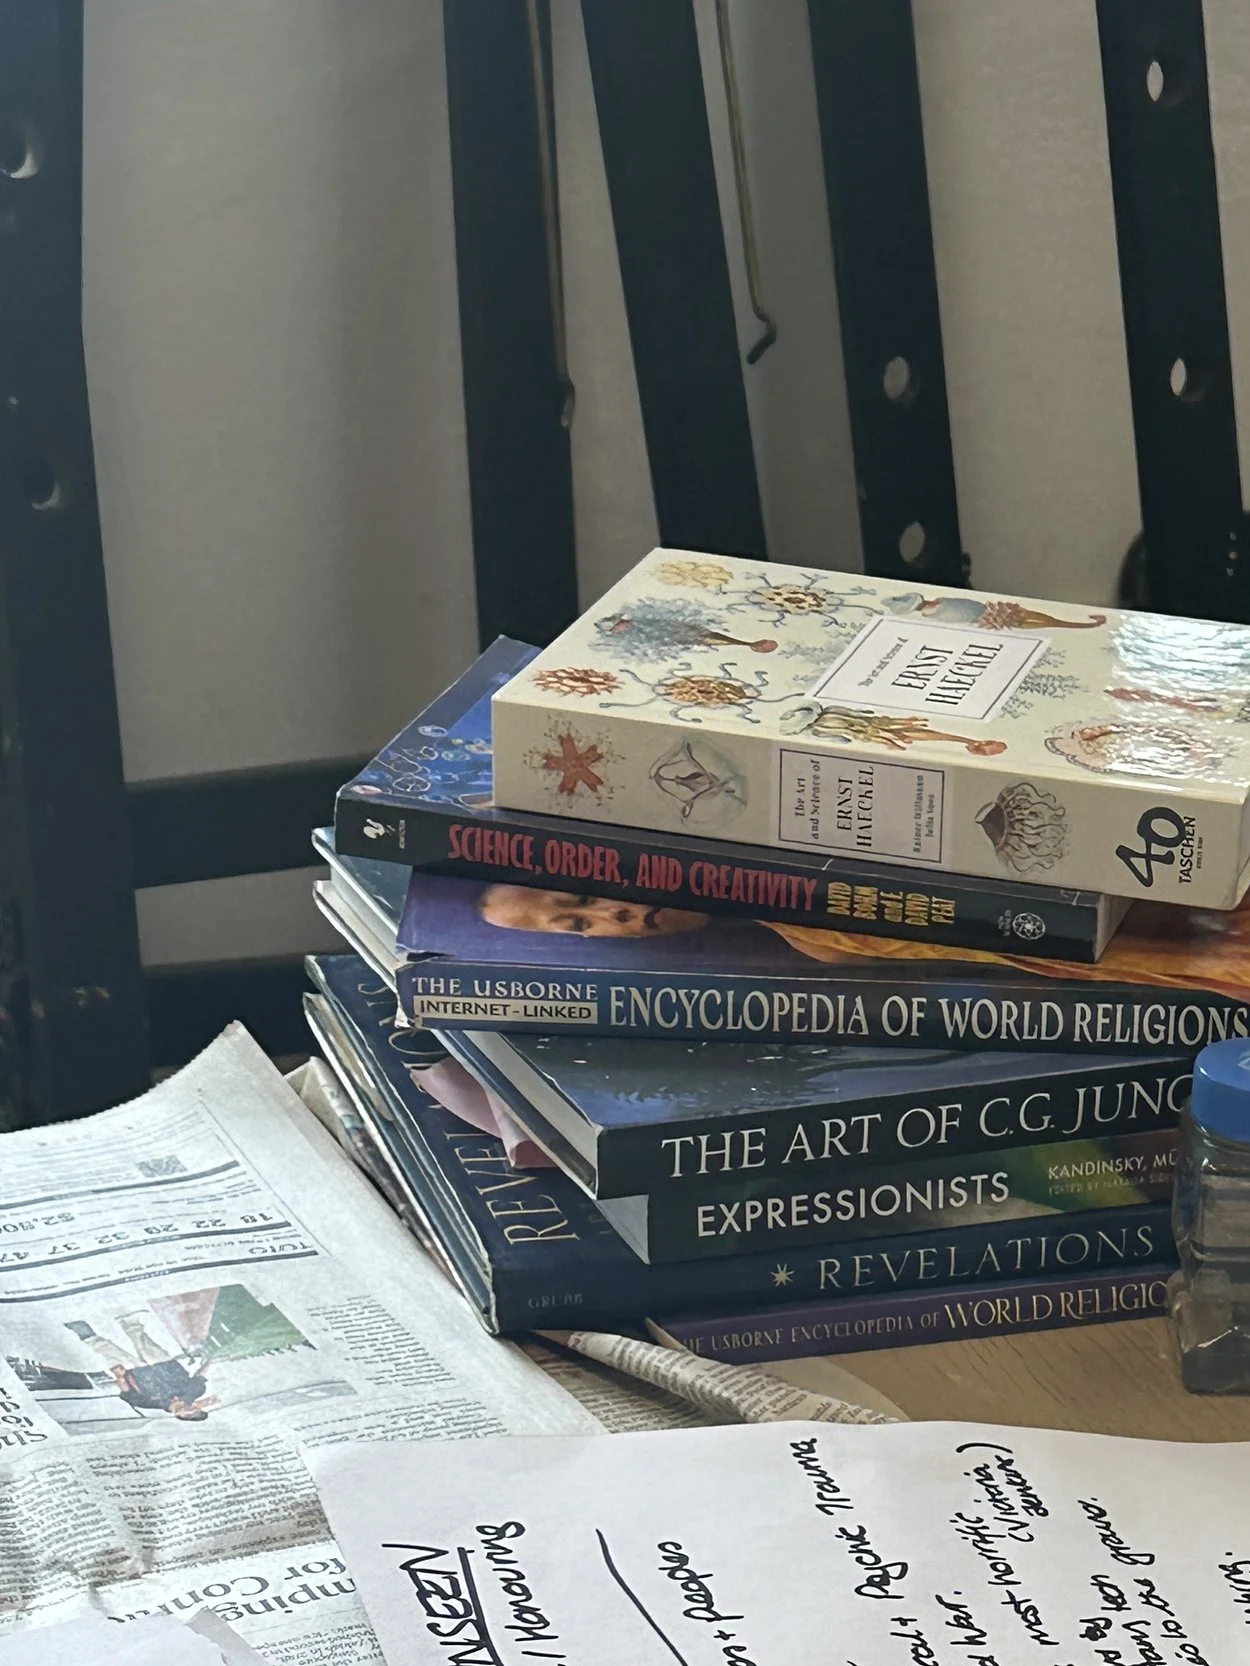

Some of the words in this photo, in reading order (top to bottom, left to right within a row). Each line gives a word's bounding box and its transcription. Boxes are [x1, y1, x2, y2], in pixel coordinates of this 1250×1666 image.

[892, 645, 954, 690] ERNST
[926, 643, 1003, 706] HAECKEL
[810, 759, 821, 772] of
[810, 817, 820, 840] and
[837, 776, 853, 831] ERNST
[856, 766, 874, 847] HAECKEL
[447, 824, 542, 874] SCIENCE,
[545, 839, 628, 886] ORDER,
[636, 854, 682, 891] AND
[690, 860, 817, 911] CREATIVITY
[1116, 806, 1183, 888] 40
[1178, 816, 1197, 885] TASCHEN
[412, 976, 461, 996] THE
[474, 979, 599, 1000] USBORNE
[610, 986, 869, 1035] ENCYCLOPEDIA
[881, 995, 928, 1038] OF
[938, 995, 1064, 1043] WORLD
[1072, 1001, 1249, 1046] RELIGIONS
[661, 1130, 767, 1178] THE
[781, 1112, 883, 1166] ART
[896, 1103, 962, 1149] OF
[979, 1091, 1056, 1137] C.G.
[1048, 1155, 1148, 1180] KANDINSKY,
[696, 1171, 1011, 1238] EXPRESSIONISTS
[819, 1225, 1155, 1290] REVELATIONS
[711, 1328, 784, 1352] USBORNE
[792, 1315, 915, 1345] ENCYCLOPEDIA
[920, 1312, 940, 1328] OF
[943, 1294, 1053, 1328] WORLD
